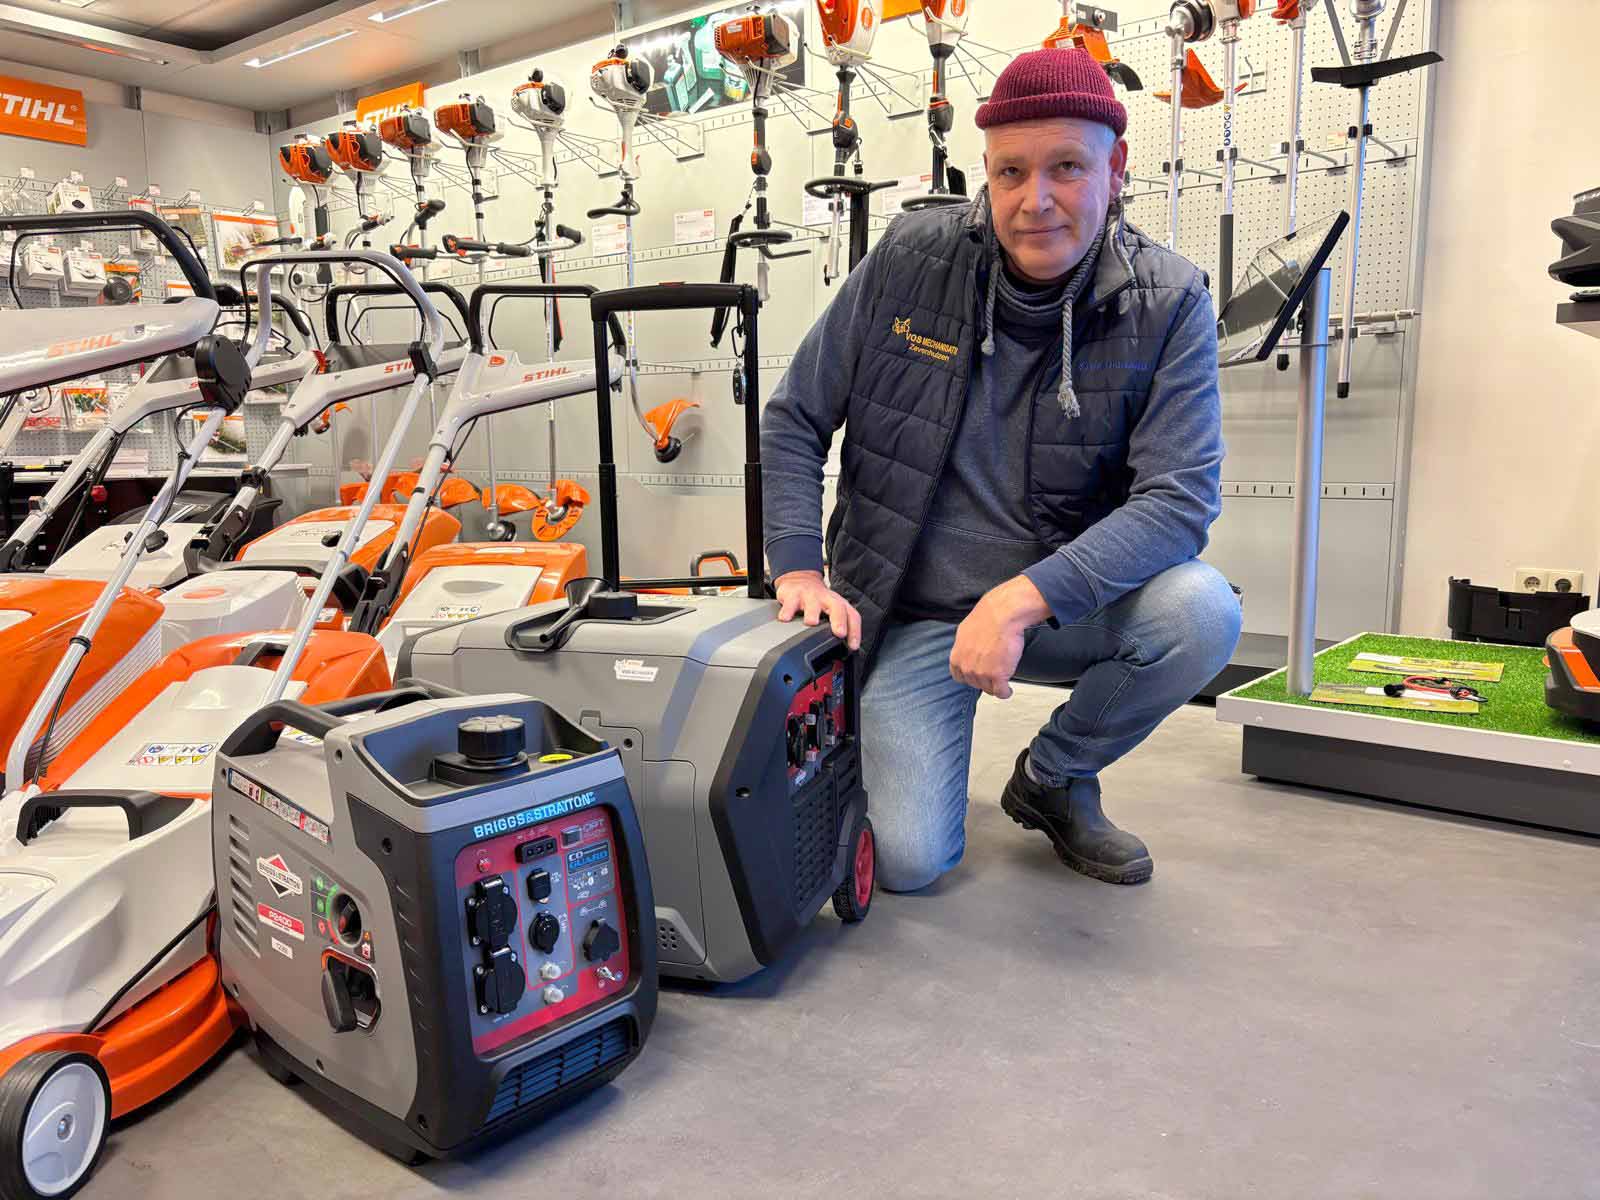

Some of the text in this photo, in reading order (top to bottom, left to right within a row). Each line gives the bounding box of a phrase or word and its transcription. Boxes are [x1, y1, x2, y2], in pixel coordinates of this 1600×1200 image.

[0, 93, 75, 126] TIHL
[47, 335, 121, 359] STIHL
[906, 332, 923, 344] VOS
[521, 366, 571, 383] STIHL
